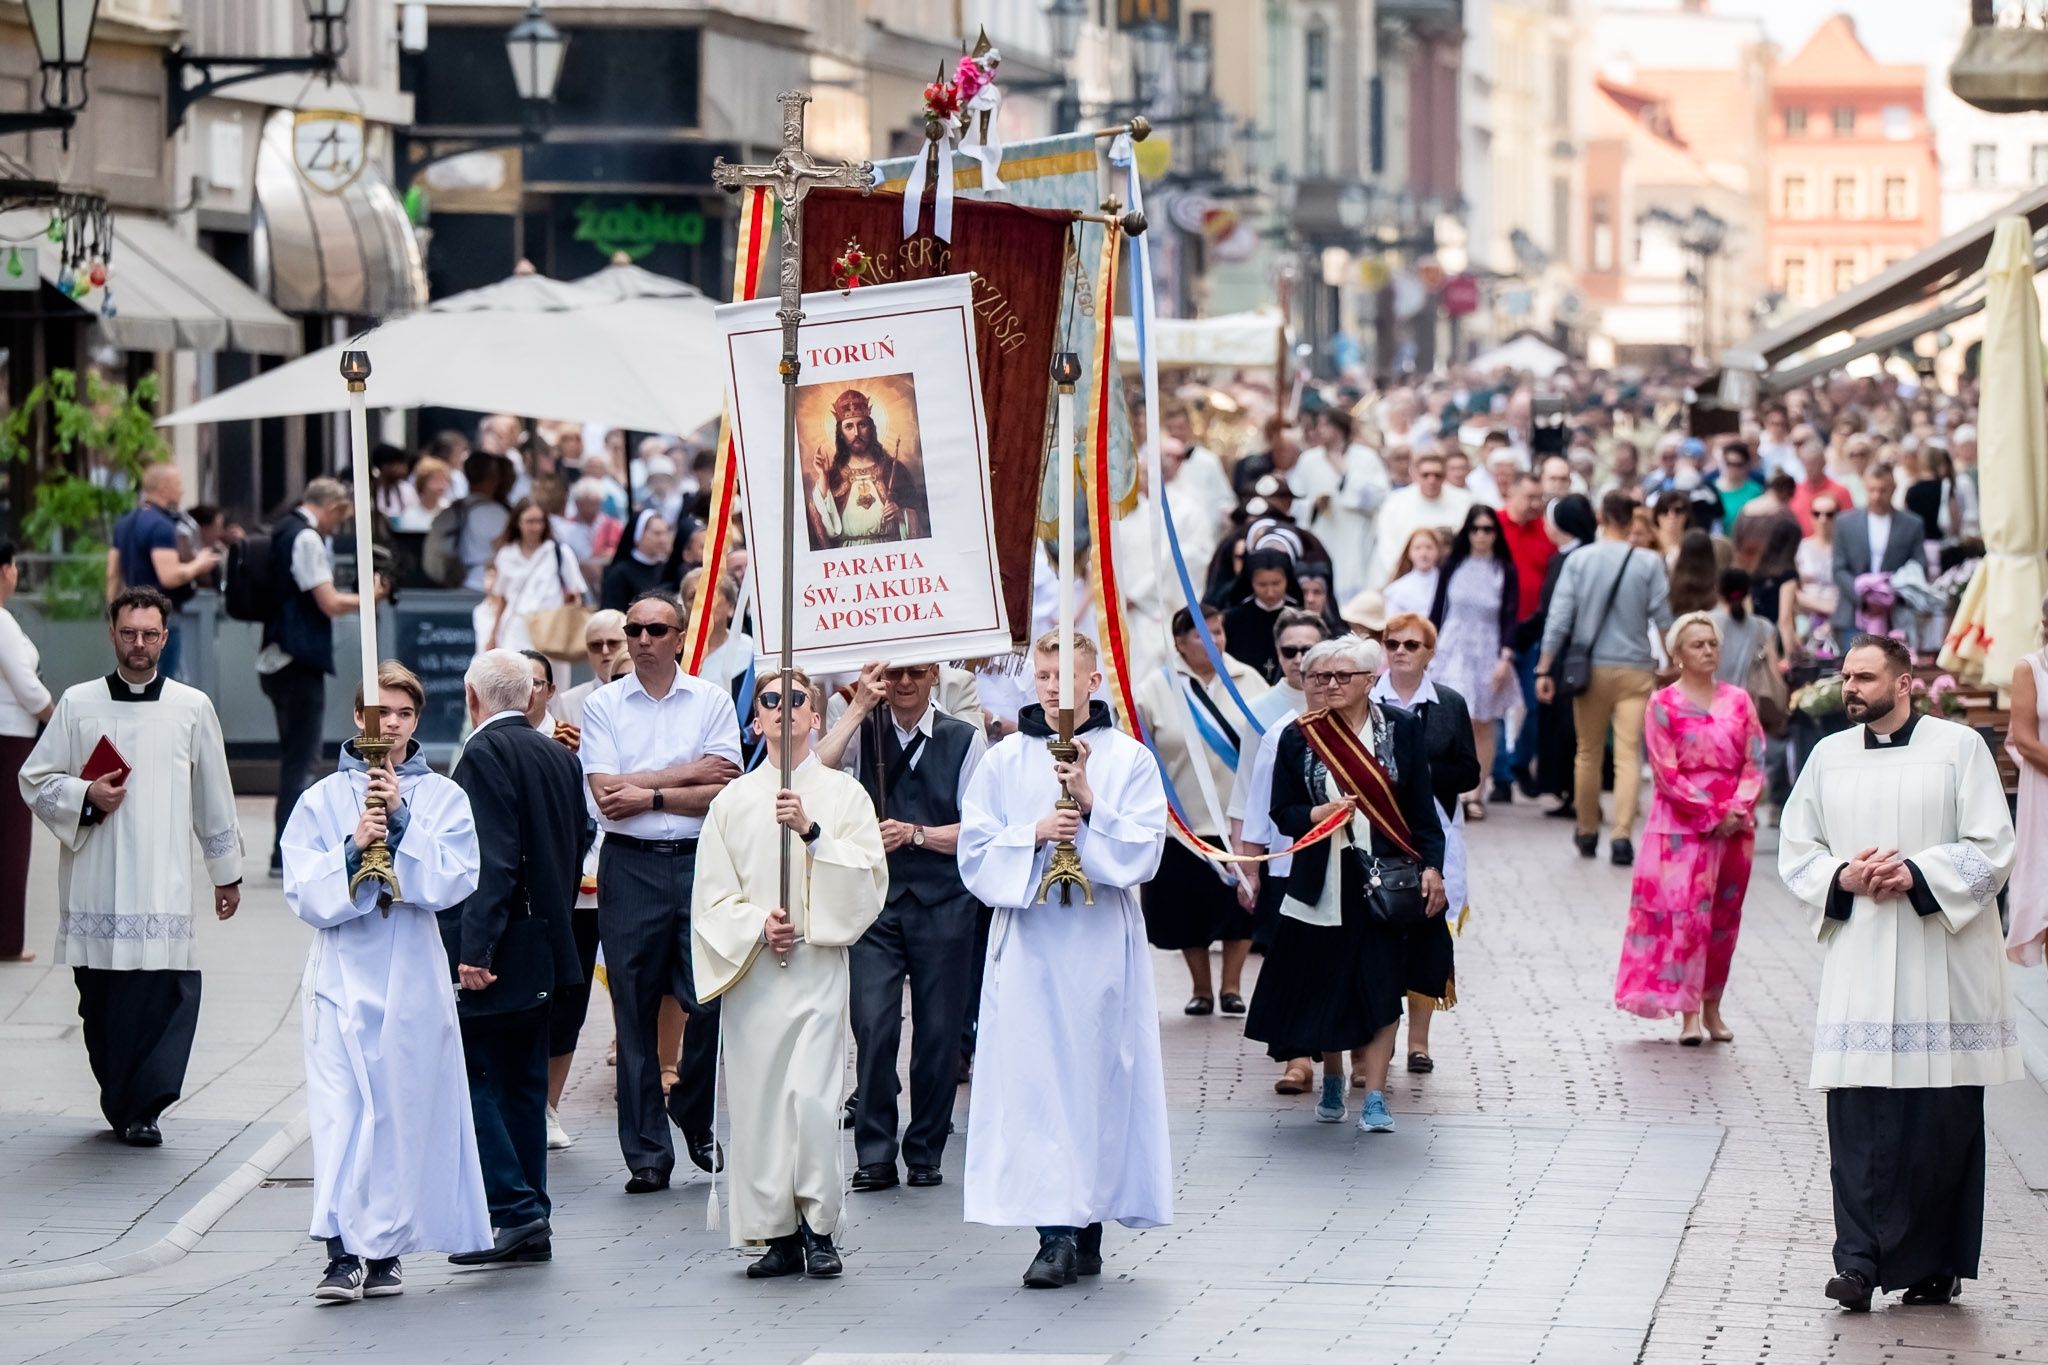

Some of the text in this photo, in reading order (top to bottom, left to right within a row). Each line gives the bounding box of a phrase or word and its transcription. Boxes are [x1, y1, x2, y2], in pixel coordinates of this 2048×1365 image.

[806, 334, 895, 368] TORUŃ
[823, 552, 924, 579] PARAFIA
[803, 575, 950, 608] ŚW. JAKUBA
[815, 600, 944, 632] APOSTOŁA
